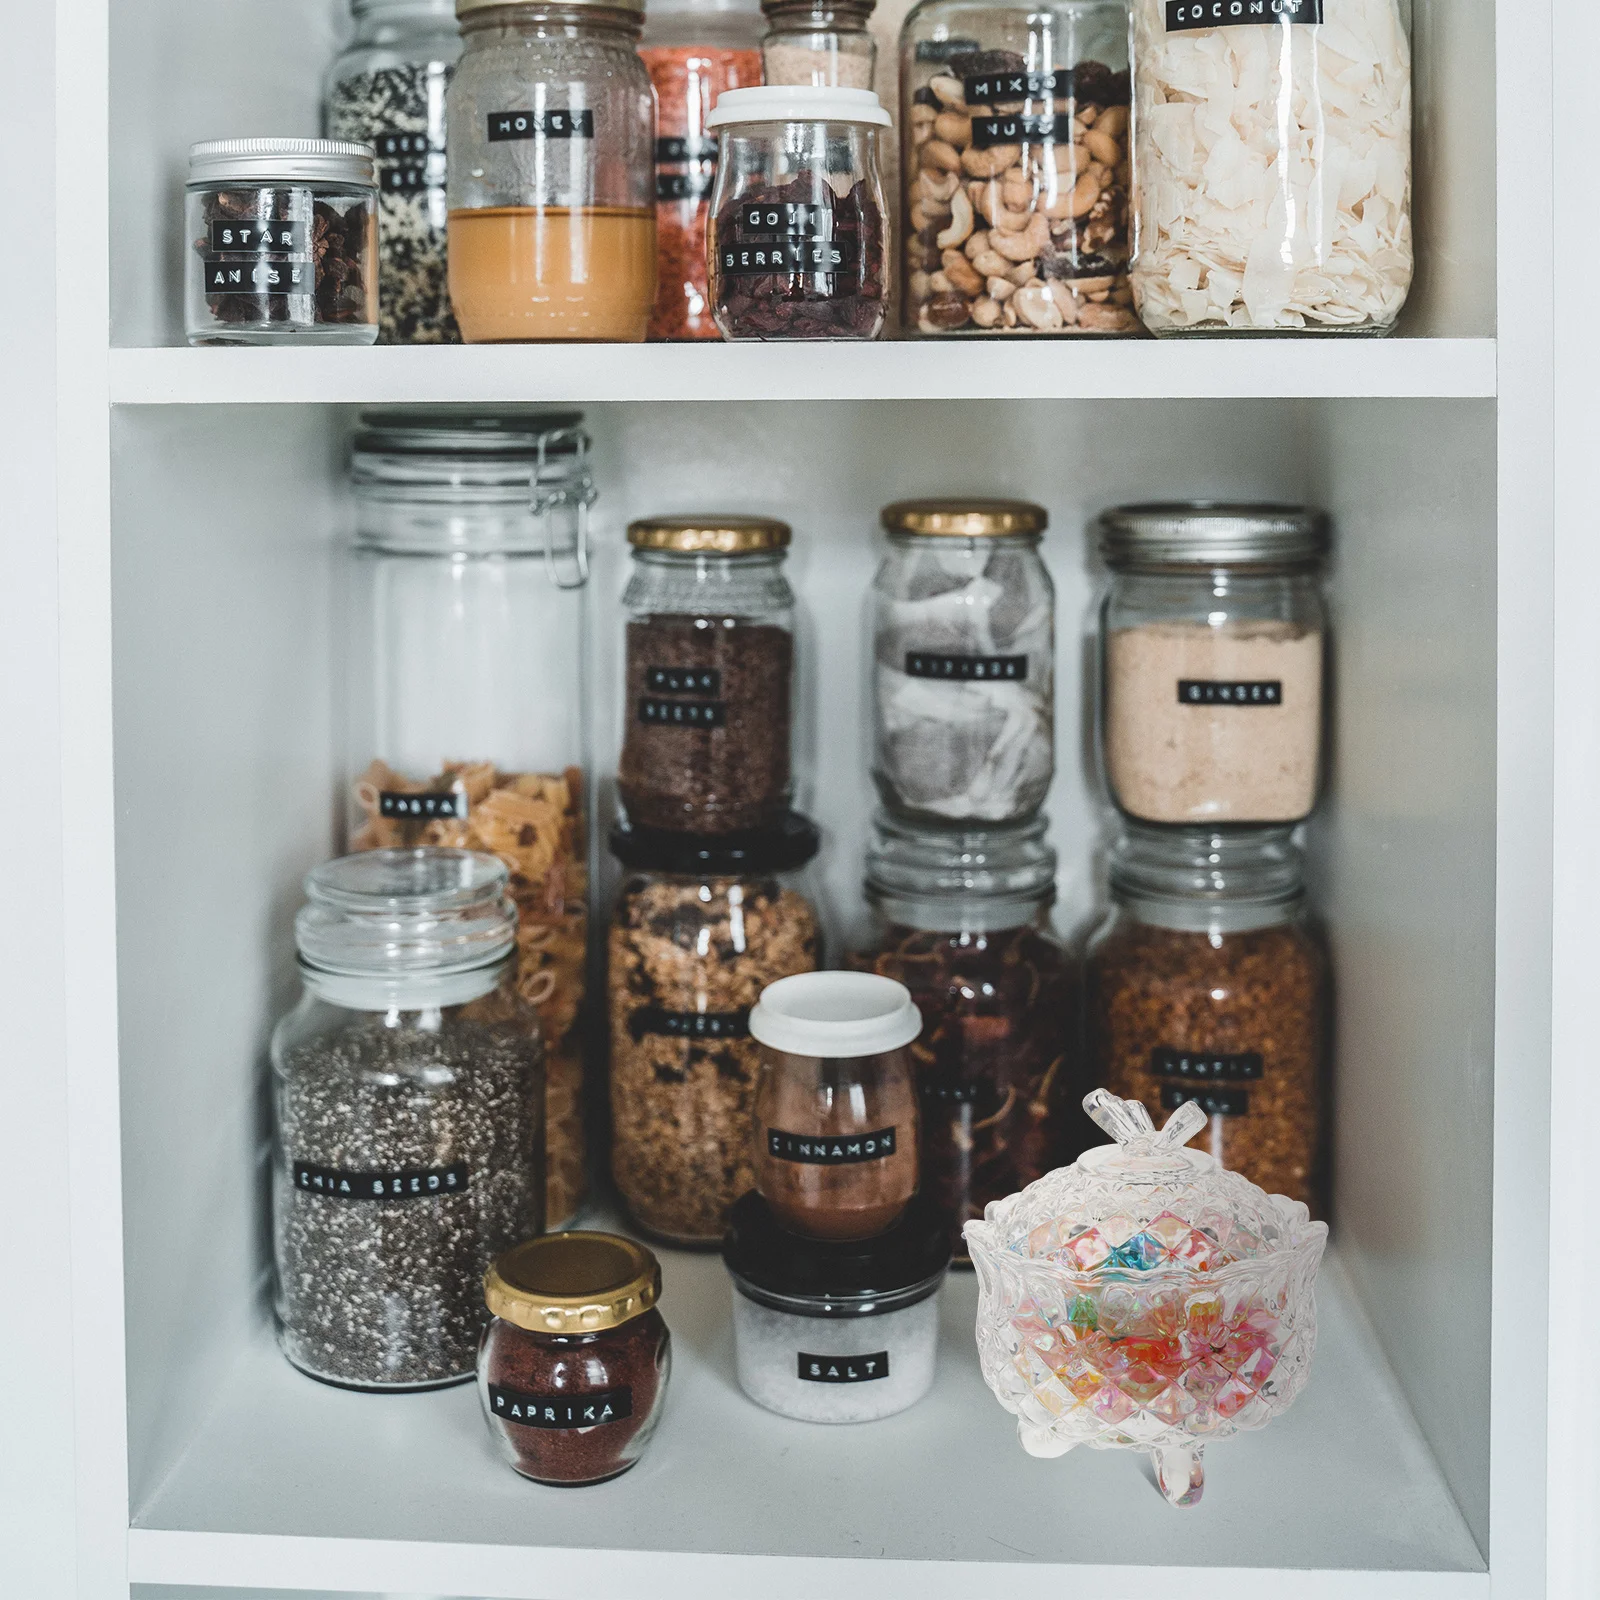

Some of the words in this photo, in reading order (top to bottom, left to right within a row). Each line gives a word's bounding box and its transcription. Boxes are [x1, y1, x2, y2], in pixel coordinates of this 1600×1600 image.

[1176, 0, 1303, 22] COCONUT
[975, 75, 1057, 96] MIXED
[499, 115, 583, 133] HONEY
[986, 121, 1054, 137] NUTS
[749, 210, 816, 226] GOJI
[222, 228, 294, 247] STAR
[725, 249, 842, 268] BERRIES
[213, 268, 301, 285] ANISE
[772, 1135, 893, 1157] CINNAMON
[300, 1171, 351, 1193] CHIA
[371, 1172, 458, 1195] SEEDS
[809, 1360, 878, 1379] SALT
[495, 1395, 614, 1422] PAPRIKA
